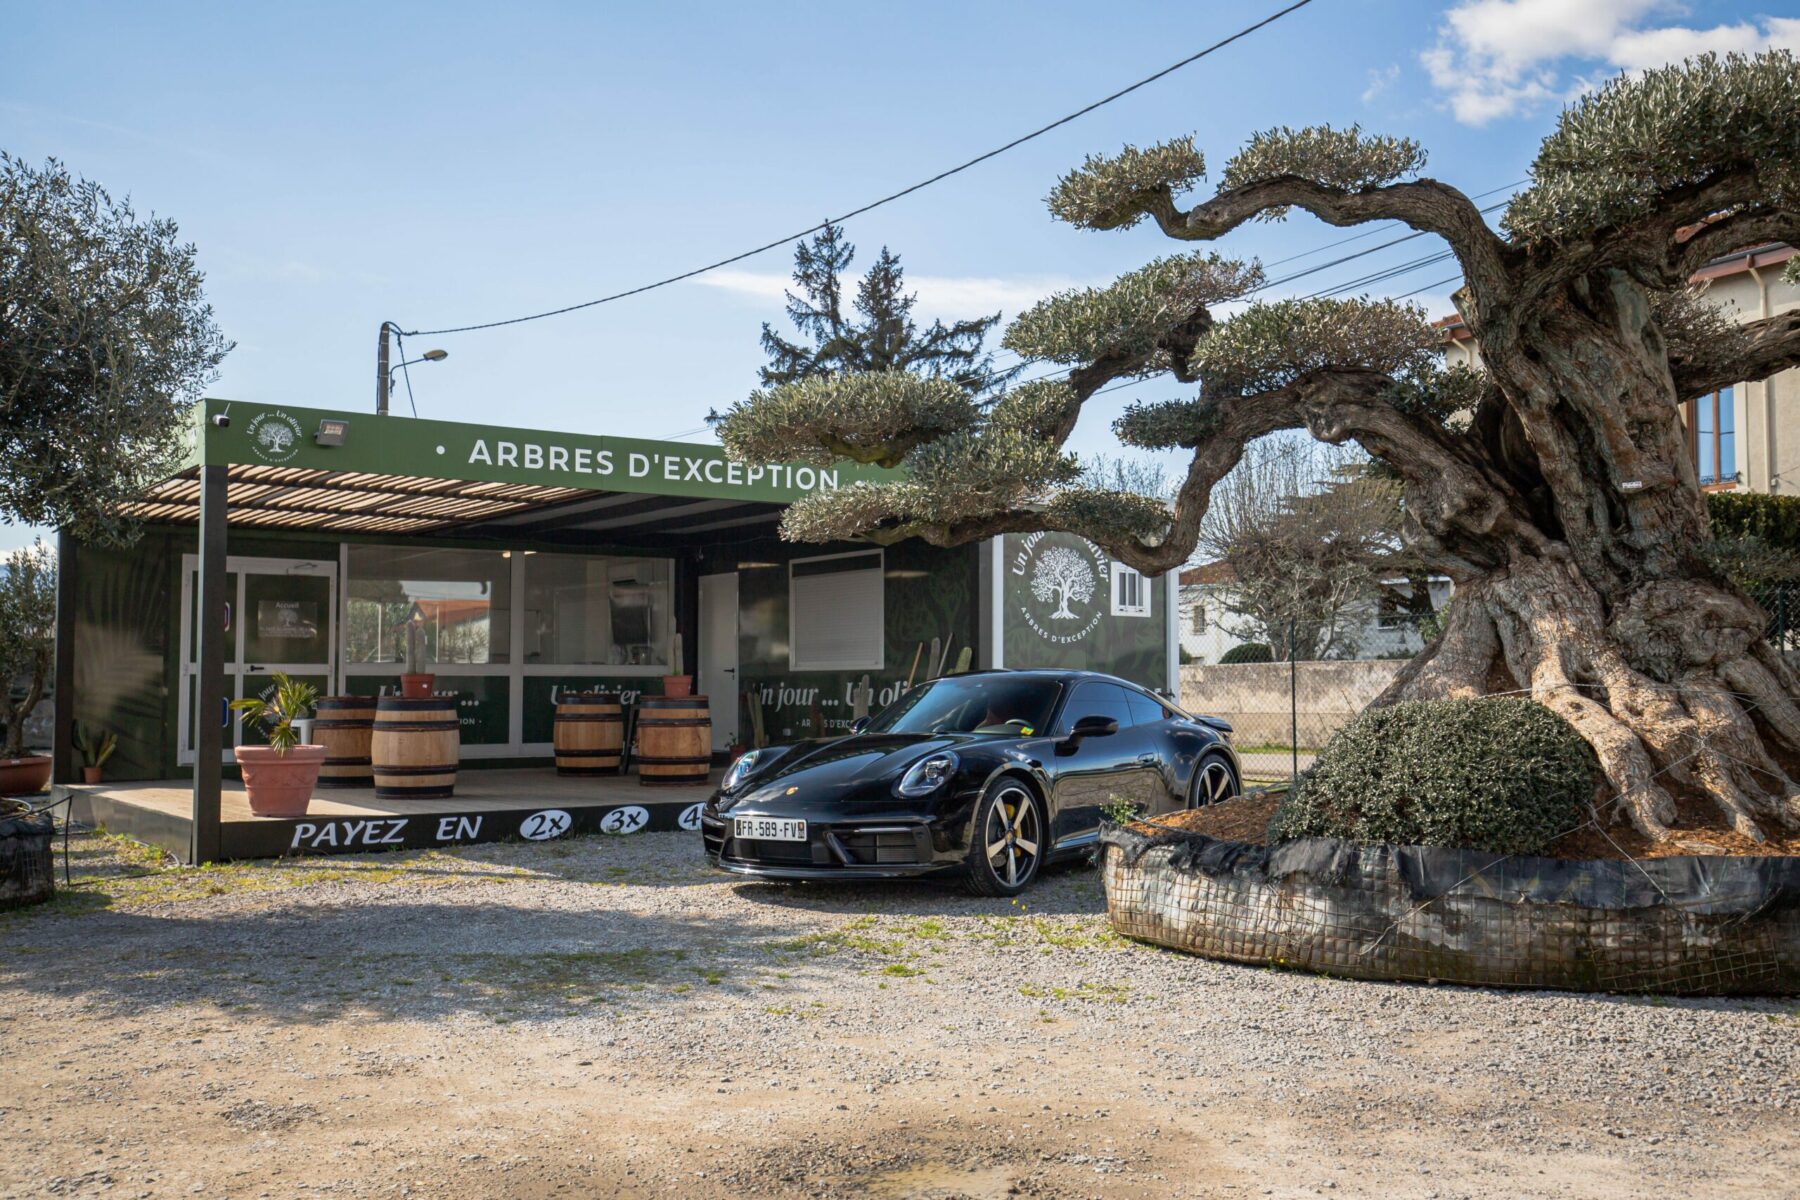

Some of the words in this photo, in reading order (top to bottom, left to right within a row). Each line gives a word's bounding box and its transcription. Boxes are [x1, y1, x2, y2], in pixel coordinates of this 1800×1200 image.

[468, 439, 614, 475] ARBRES
[628, 453, 838, 490] D'EXCEPTION
[1012, 552, 1028, 576] Un
[1020, 607, 1049, 639] ARBRES
[1051, 610, 1103, 644] D'EXCEPTION
[775, 682, 819, 712] jour
[290, 818, 409, 848] PAYEZ
[436, 815, 482, 841] EN
[529, 814, 564, 838] 2x
[608, 809, 642, 832] 3x
[683, 805, 701, 827] 4
